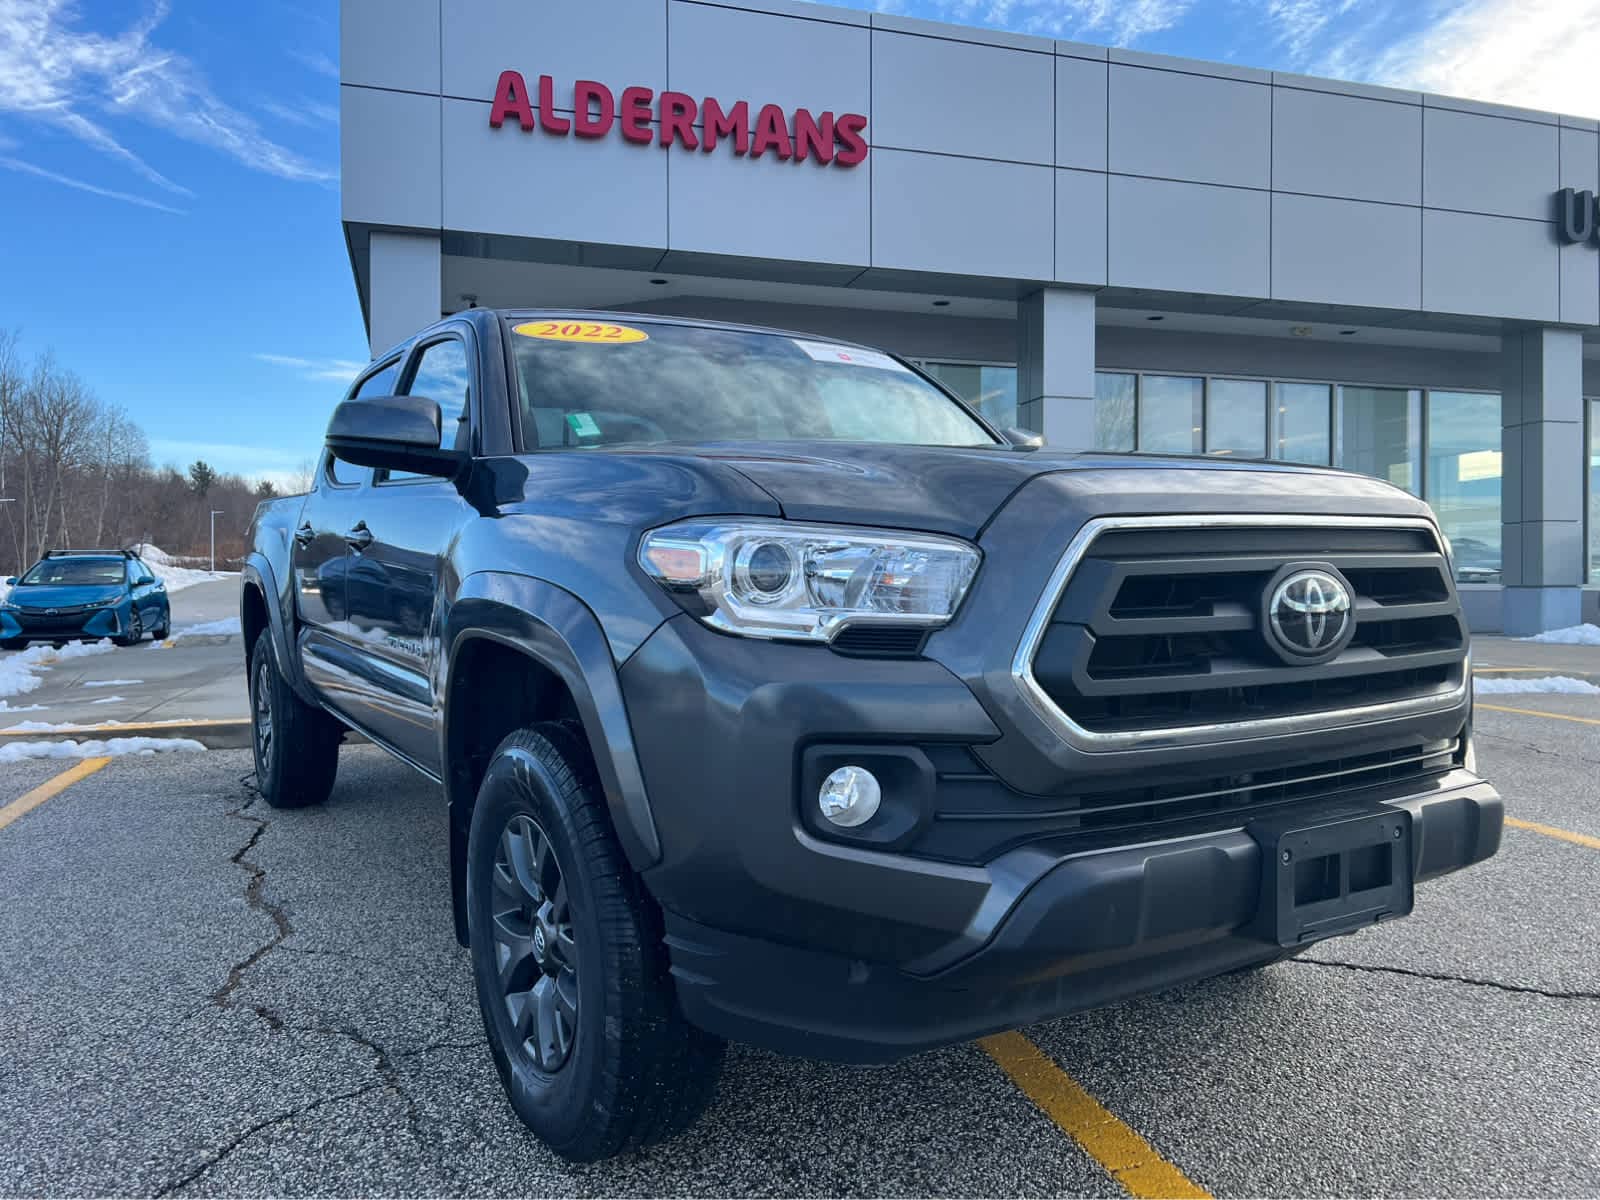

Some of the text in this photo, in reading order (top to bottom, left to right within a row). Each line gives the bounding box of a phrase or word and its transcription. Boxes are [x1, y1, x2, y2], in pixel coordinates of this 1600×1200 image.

[489, 69, 869, 168] ALDERMANS
[1556, 187, 1600, 247] U
[538, 323, 623, 339] 2022
